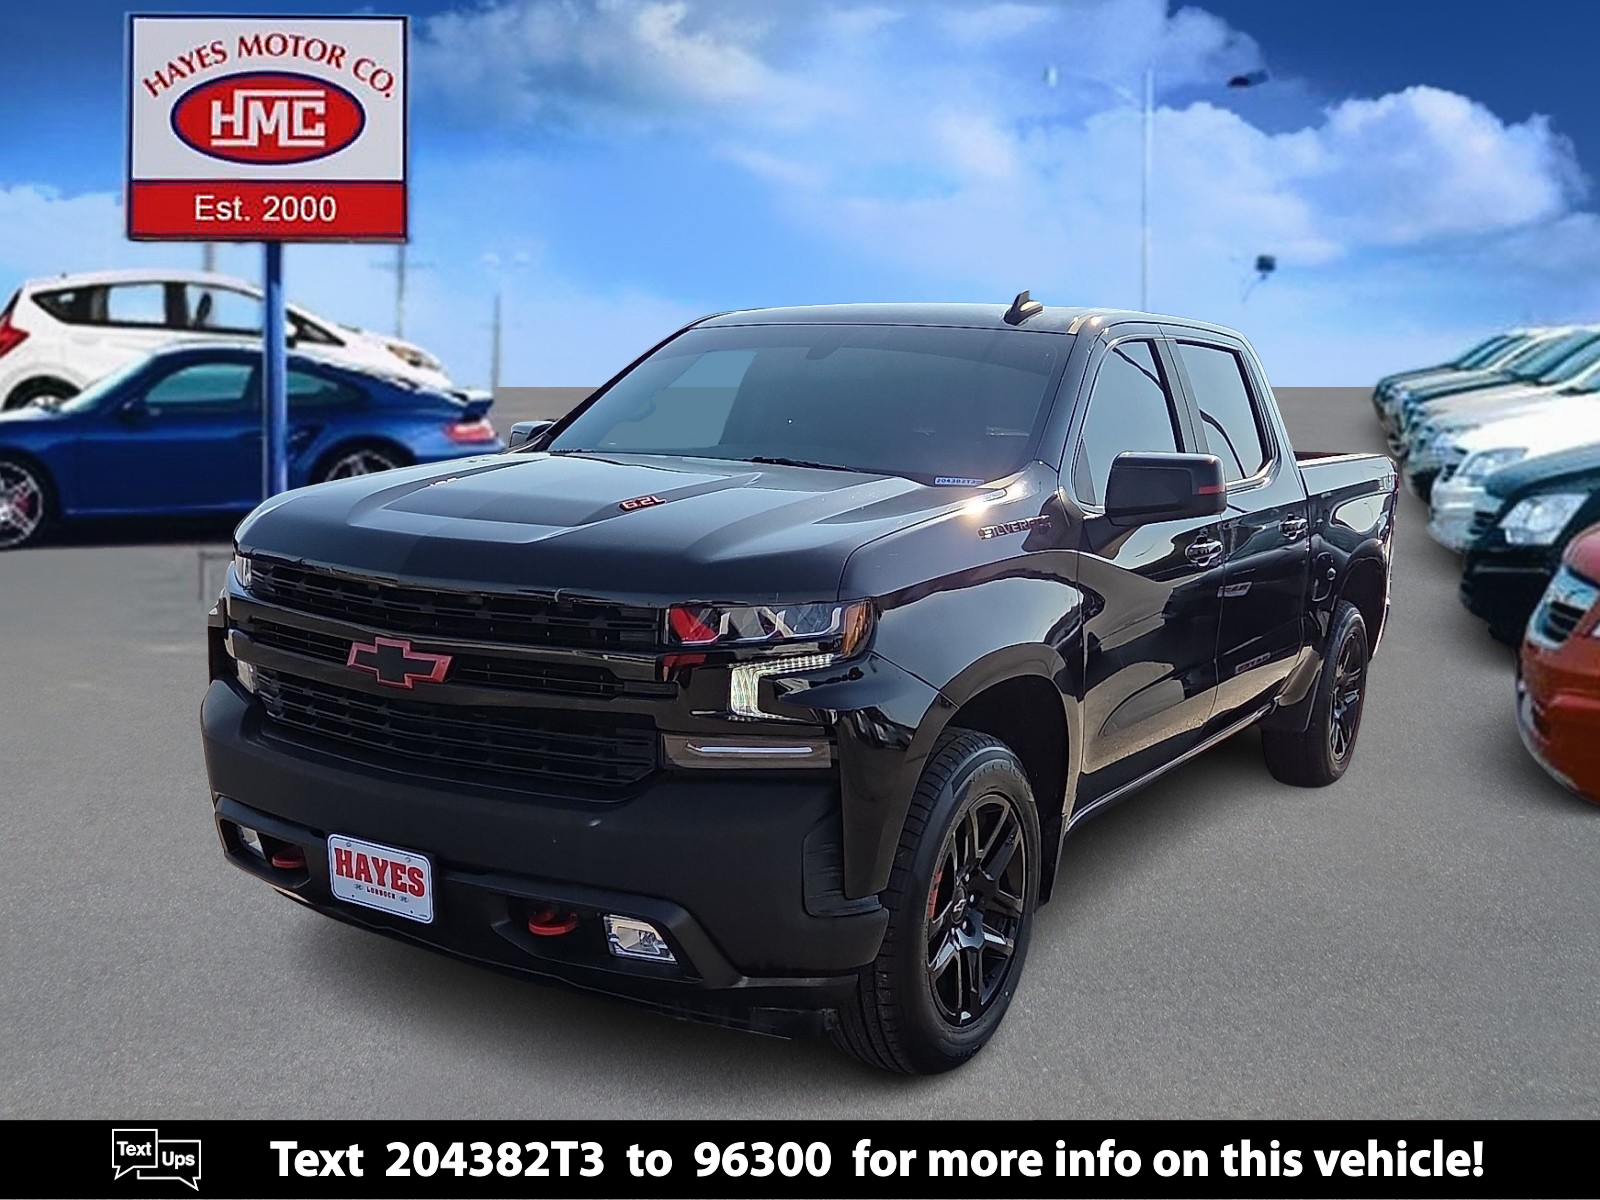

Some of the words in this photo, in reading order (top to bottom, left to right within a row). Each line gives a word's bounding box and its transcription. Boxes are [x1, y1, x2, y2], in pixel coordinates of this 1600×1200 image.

[142, 40, 228, 98] HAYES
[238, 32, 347, 69] MOTOR
[352, 57, 395, 99] CO.
[210, 89, 327, 147] HMC
[194, 195, 251, 221] Est.
[262, 195, 337, 222] 2000
[620, 495, 666, 510] 6.2L
[978, 515, 1052, 539] SILVER
[333, 847, 425, 898] HAYES
[366, 886, 396, 900] LUBBOCK
